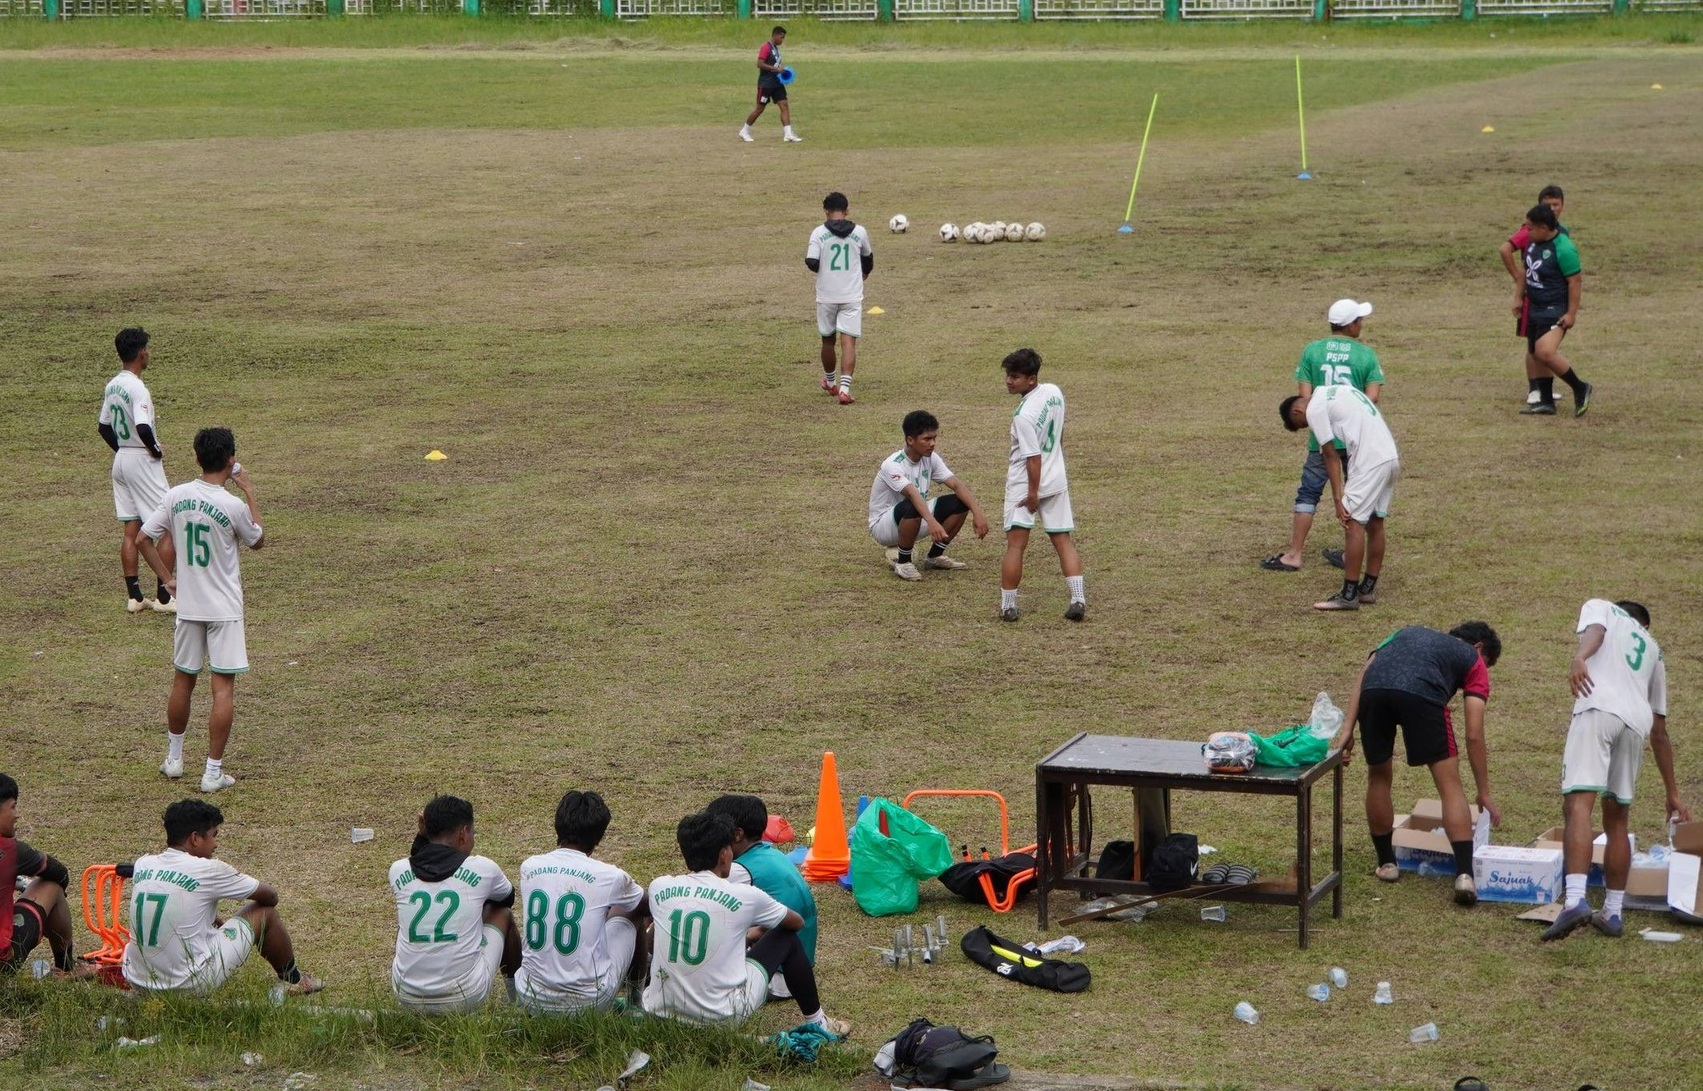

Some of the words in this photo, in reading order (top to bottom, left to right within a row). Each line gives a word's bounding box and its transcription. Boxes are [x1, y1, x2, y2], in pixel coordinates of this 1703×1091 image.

[829, 243, 849, 271] 21
[1326, 352, 1349, 363] PSPP
[110, 404, 130, 440] 23
[171, 499, 197, 516] PADANG
[199, 500, 230, 528] PANJANG
[184, 520, 210, 567] 15
[1625, 631, 1646, 671] 3
[154, 869, 200, 892] PANJANG
[395, 869, 418, 890] PADA
[451, 866, 482, 888] JANG
[529, 866, 559, 879] PADANG
[560, 867, 596, 884] PANJANG
[1489, 870, 1533, 885] Sajuak
[654, 886, 690, 905] PADANG
[694, 886, 743, 912] PANJANG
[135, 892, 169, 947] 17
[408, 889, 460, 943] 22
[526, 888, 586, 956] 88
[667, 908, 711, 966] 10
